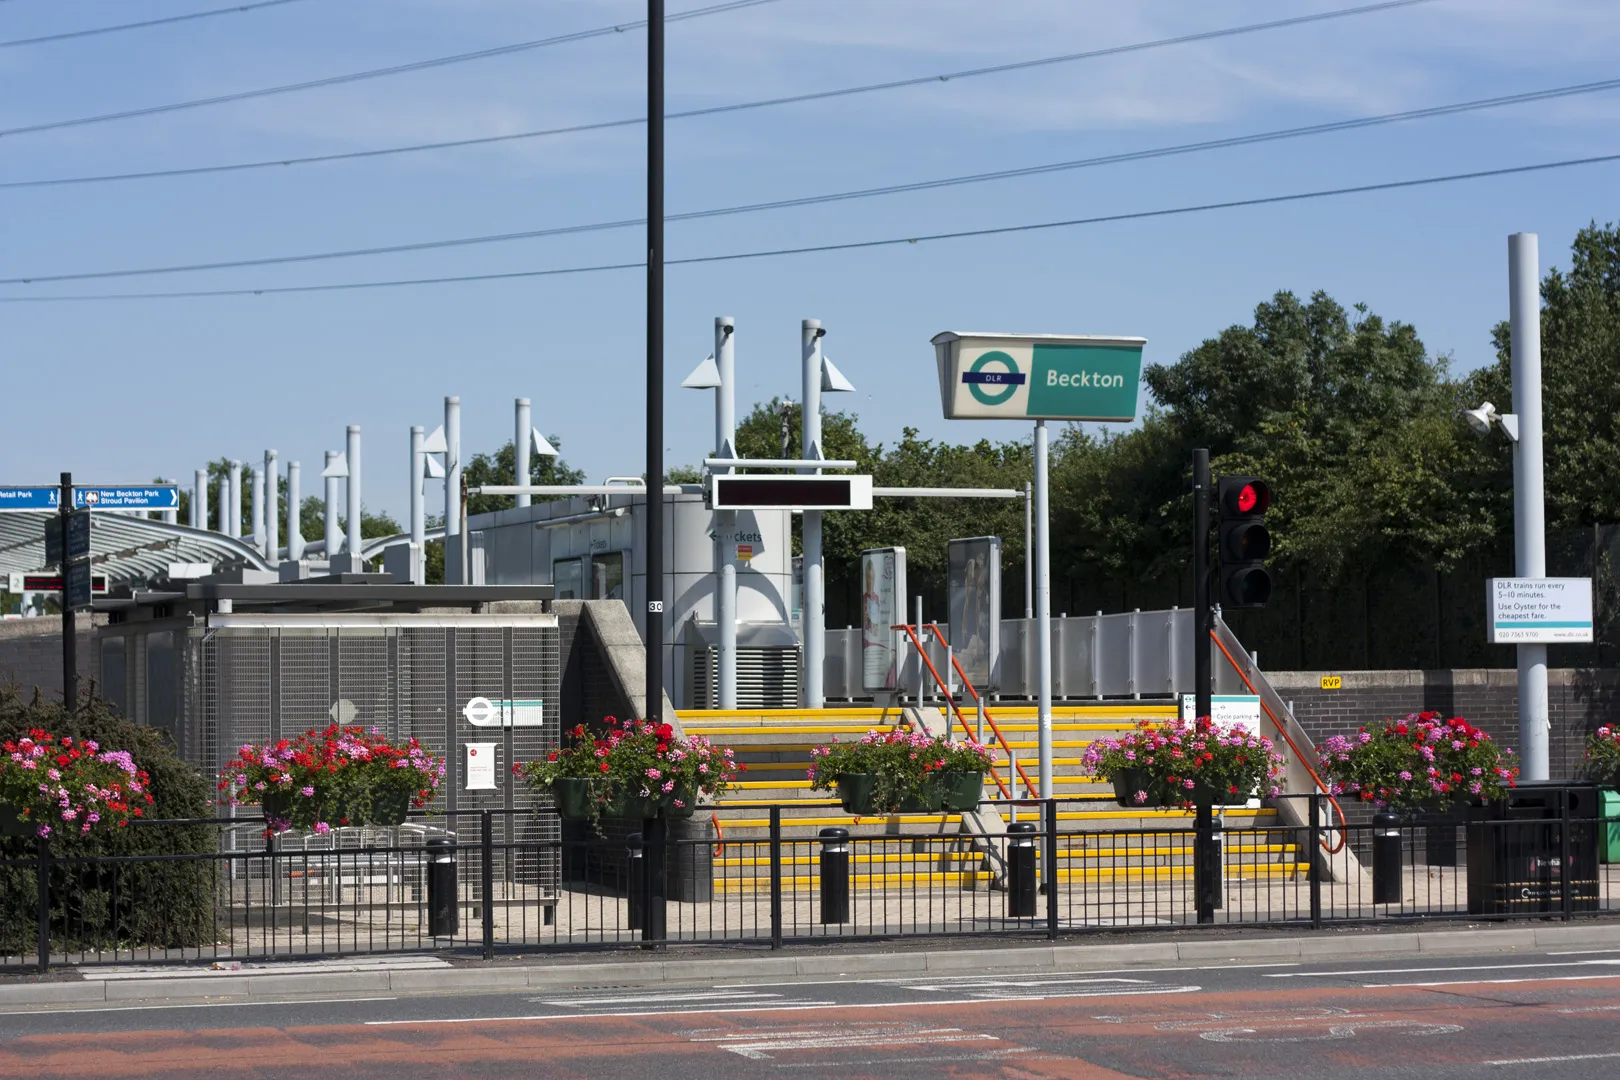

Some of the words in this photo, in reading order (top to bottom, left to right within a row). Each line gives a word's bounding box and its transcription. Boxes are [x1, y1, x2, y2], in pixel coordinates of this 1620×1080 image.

[985, 374, 1002, 382] DLR
[1046, 369, 1124, 388] Beckton
[17, 490, 33, 499] Park
[100, 490, 115, 498] New
[116, 490, 143, 498] Beckton
[144, 490, 159, 498] Park
[734, 530, 762, 542] ckets
[1547, 583, 1565, 591] every
[1516, 591, 1546, 599] minutes.
[649, 602, 662, 611] 30
[1513, 602, 1537, 612] Oyster
[1538, 602, 1549, 610] for
[1498, 612, 1529, 620] cheapest
[1531, 612, 1547, 620] fare.
[1322, 678, 1340, 687] RVP
